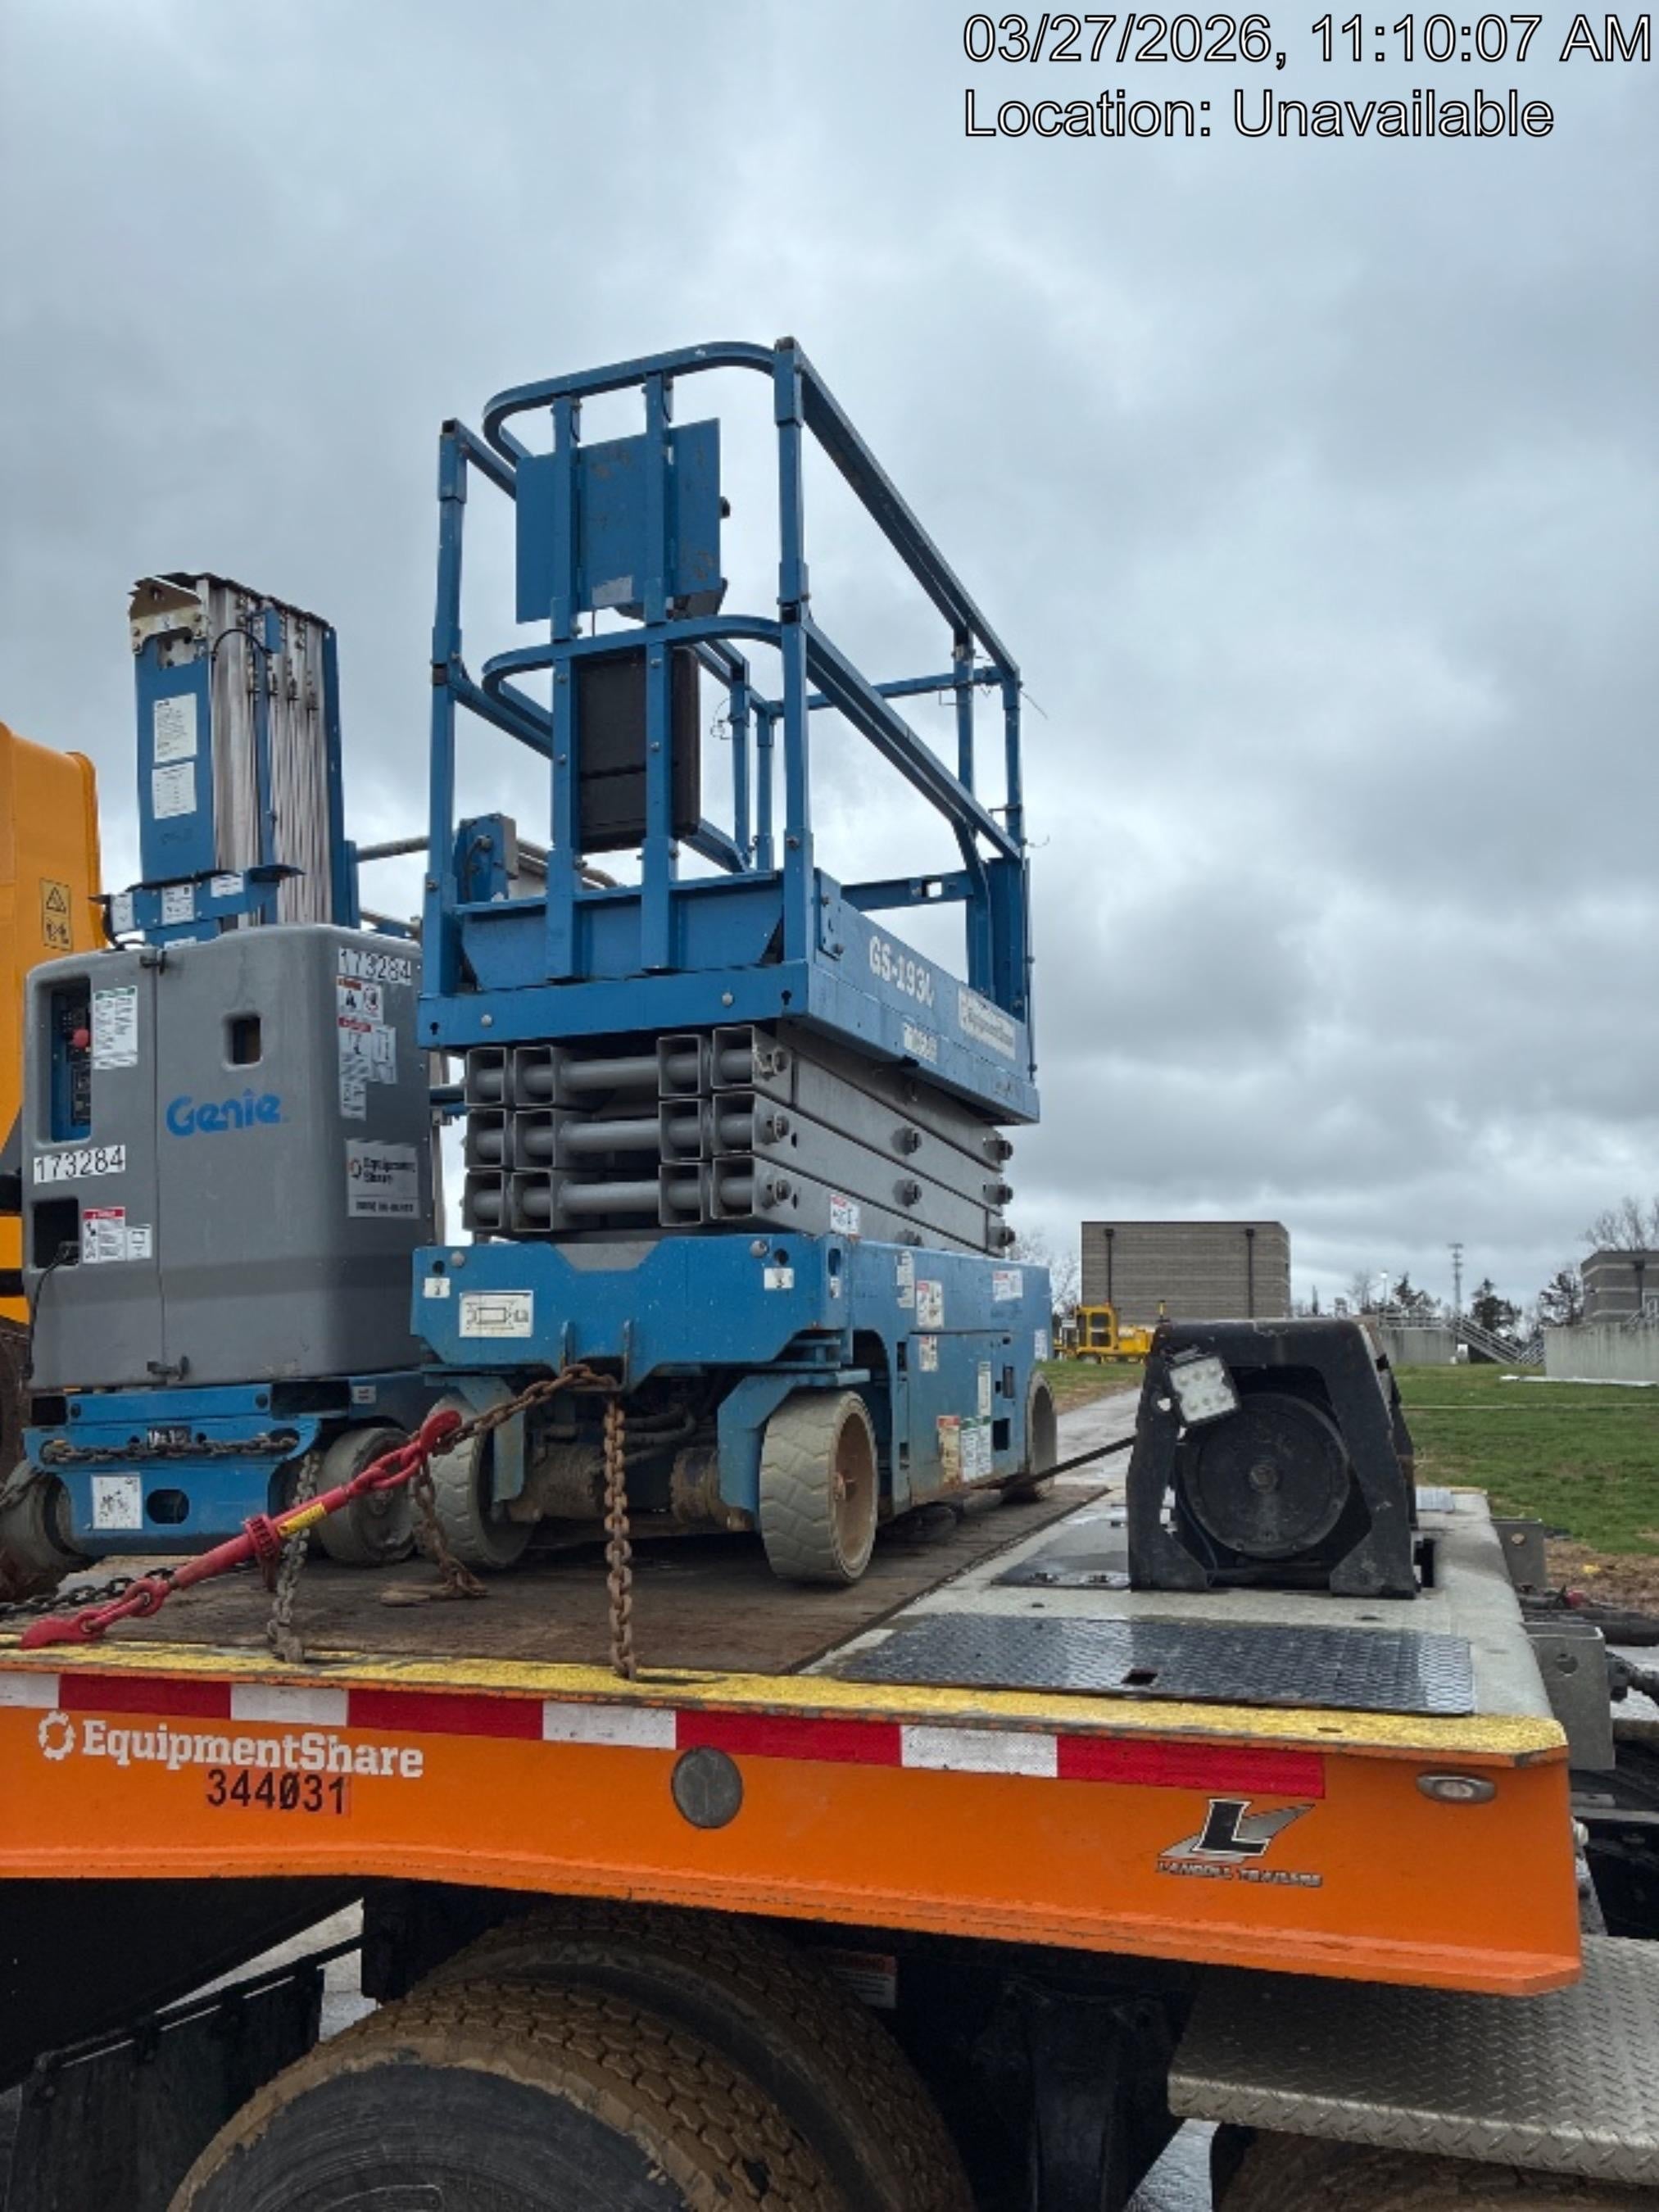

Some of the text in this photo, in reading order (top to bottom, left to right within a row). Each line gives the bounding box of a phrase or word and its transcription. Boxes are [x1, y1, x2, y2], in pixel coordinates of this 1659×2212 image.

[340, 949, 412, 981] 173284
[165, 1088, 282, 1137] Genie
[36, 1145, 125, 1181] 173284
[83, 1720, 424, 1777] EquipmentShare
[206, 1767, 345, 1815] 344031
